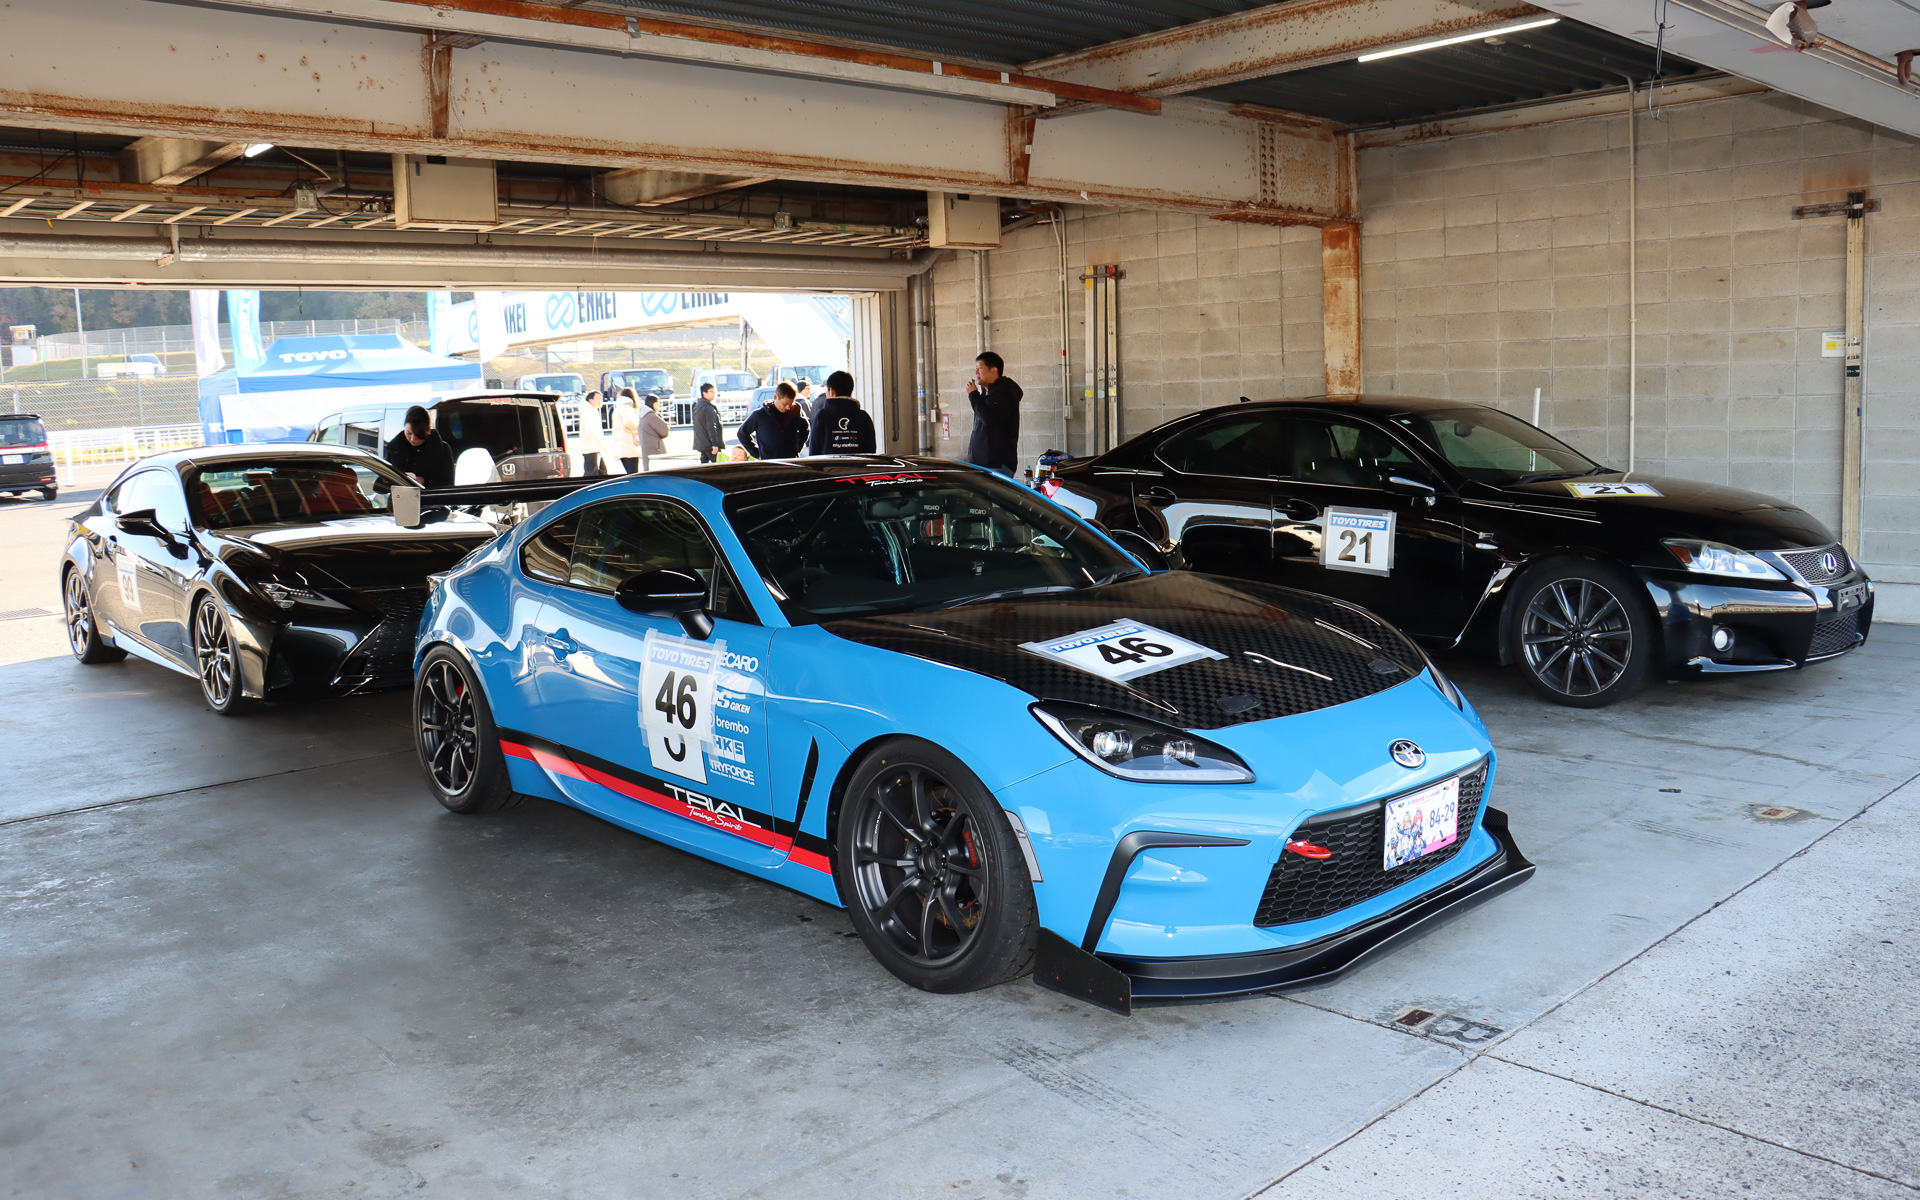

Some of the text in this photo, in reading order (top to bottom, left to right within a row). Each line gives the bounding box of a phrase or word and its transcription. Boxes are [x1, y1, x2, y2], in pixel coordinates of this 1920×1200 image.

[577, 292, 617, 323] ENKEI
[279, 349, 348, 363] TOYO
[1589, 485, 1635, 494] 21
[1332, 516, 1386, 529] TOYO TIRES
[1338, 529, 1373, 564] 21
[1050, 626, 1139, 652] TOYO TIRES
[651, 646, 711, 670] TOYO TIRES
[1097, 637, 1174, 665] 46
[655, 670, 698, 730] 46
[730, 701, 751, 714] GIKEN
[716, 715, 750, 735] brembo
[713, 734, 745, 757] HKS
[709, 759, 755, 782] TRYFORCE
[663, 782, 762, 829] TRIAL
[686, 804, 715, 822] Tuning
[1429, 801, 1456, 828] 84-29
